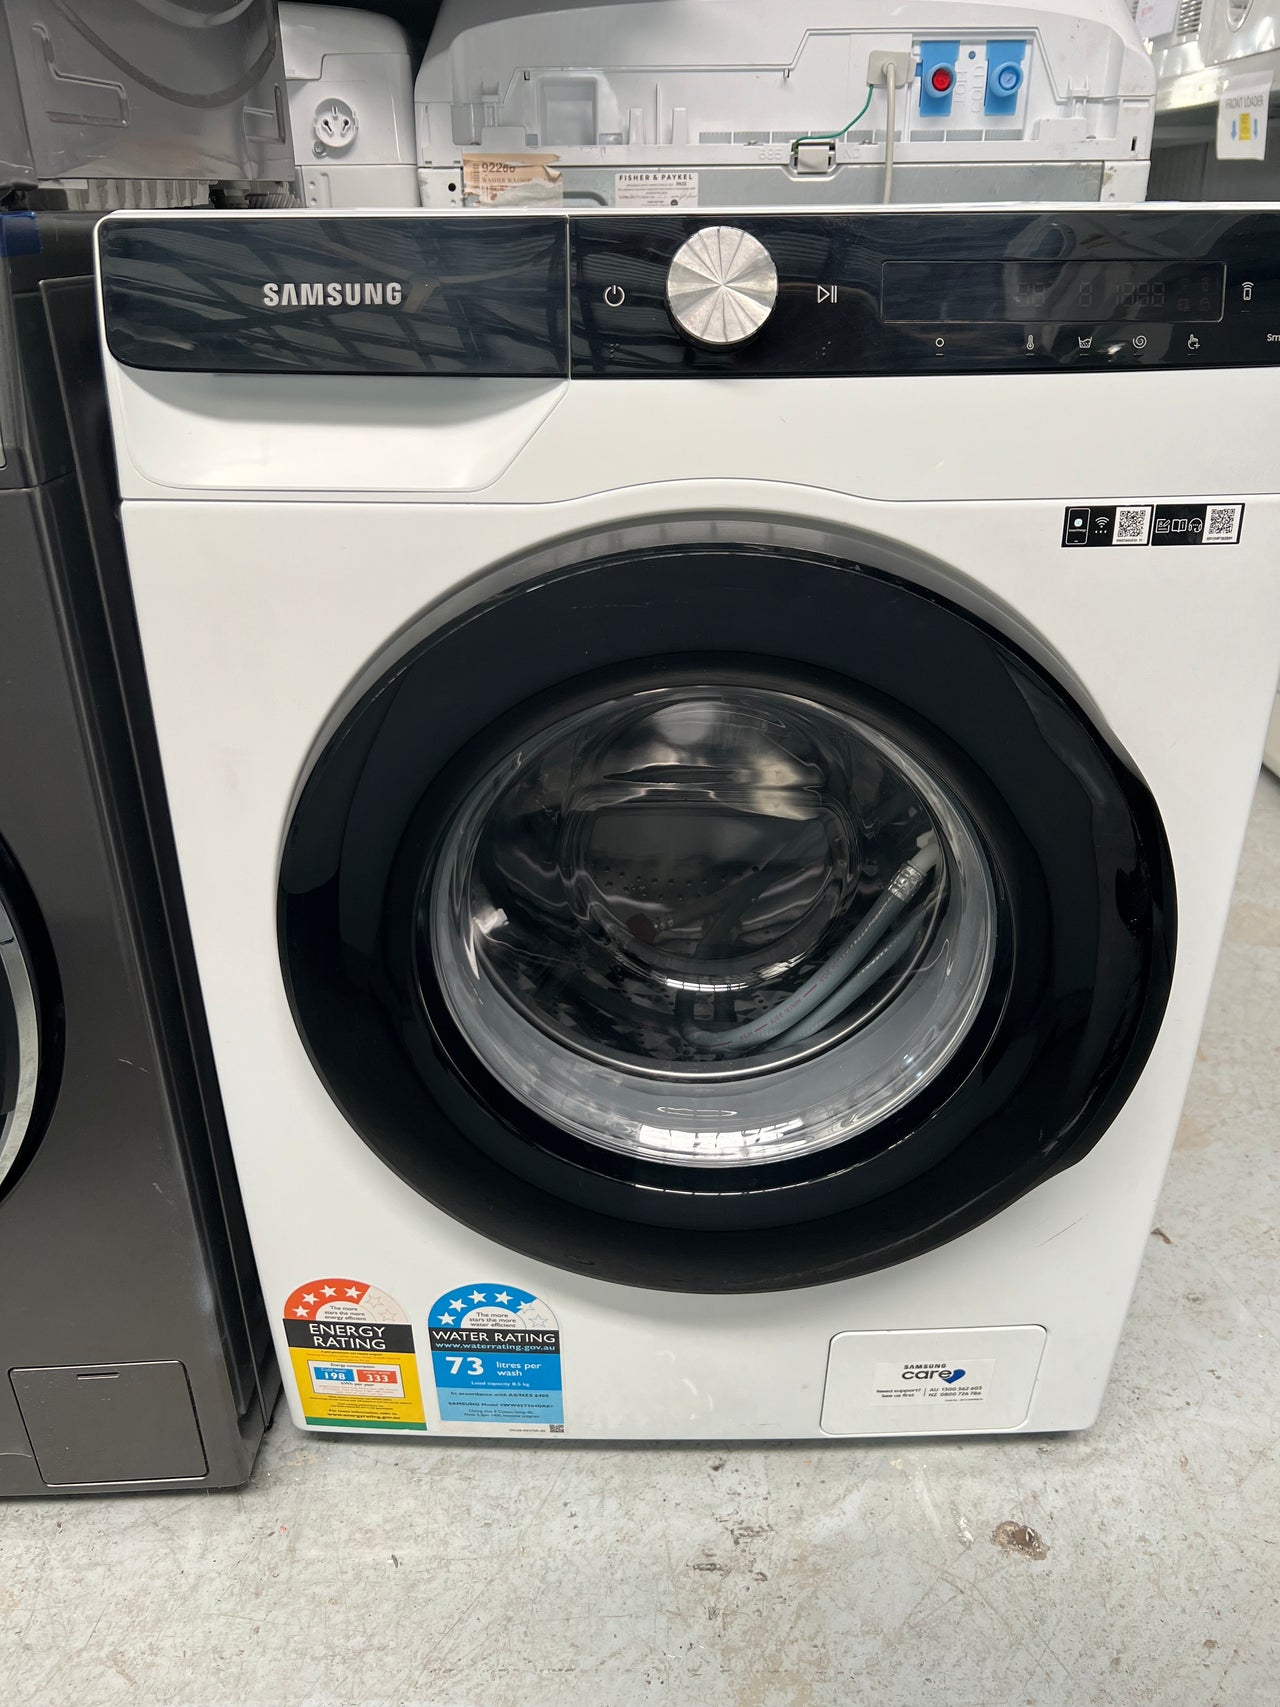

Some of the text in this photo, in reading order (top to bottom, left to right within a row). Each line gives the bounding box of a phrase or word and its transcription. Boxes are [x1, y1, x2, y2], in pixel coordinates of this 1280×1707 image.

[264, 282, 402, 306] SAMSUNG
[309, 1323, 386, 1337] ENERGY
[314, 1336, 386, 1350] RATING
[433, 1331, 555, 1343] WATER RATING
[436, 1343, 556, 1351] www.waterrating.gov.au
[446, 1357, 484, 1375] 73
[525, 1363, 542, 1371] per
[324, 1372, 346, 1380] 198
[902, 1370, 952, 1380] care
